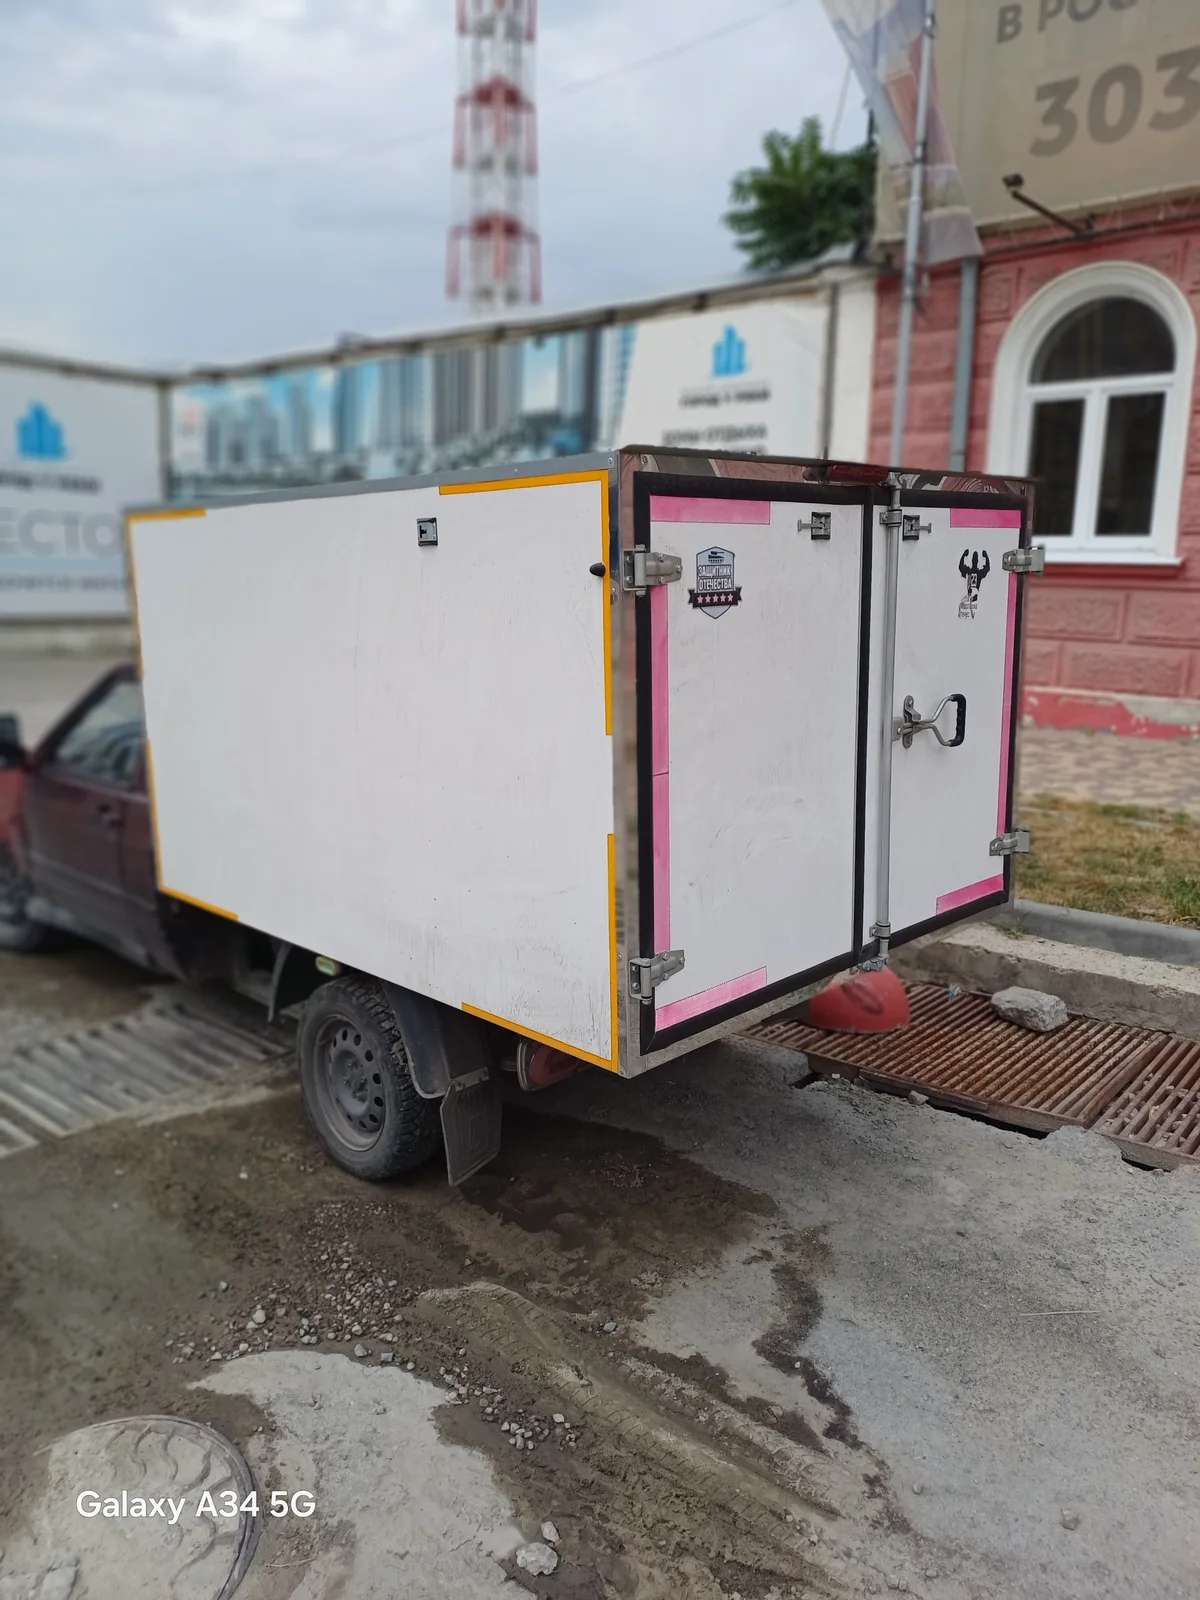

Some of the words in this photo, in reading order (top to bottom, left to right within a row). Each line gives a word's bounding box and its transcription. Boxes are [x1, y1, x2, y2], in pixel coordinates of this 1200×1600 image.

[996, 3, 1022, 43] В
[1037, 0, 1139, 33] РО
[1028, 45, 1200, 157] 303
[698, 565, 732, 578] ЗАЩИТНИК
[699, 578, 733, 591] ОТЕЧЕСТВА
